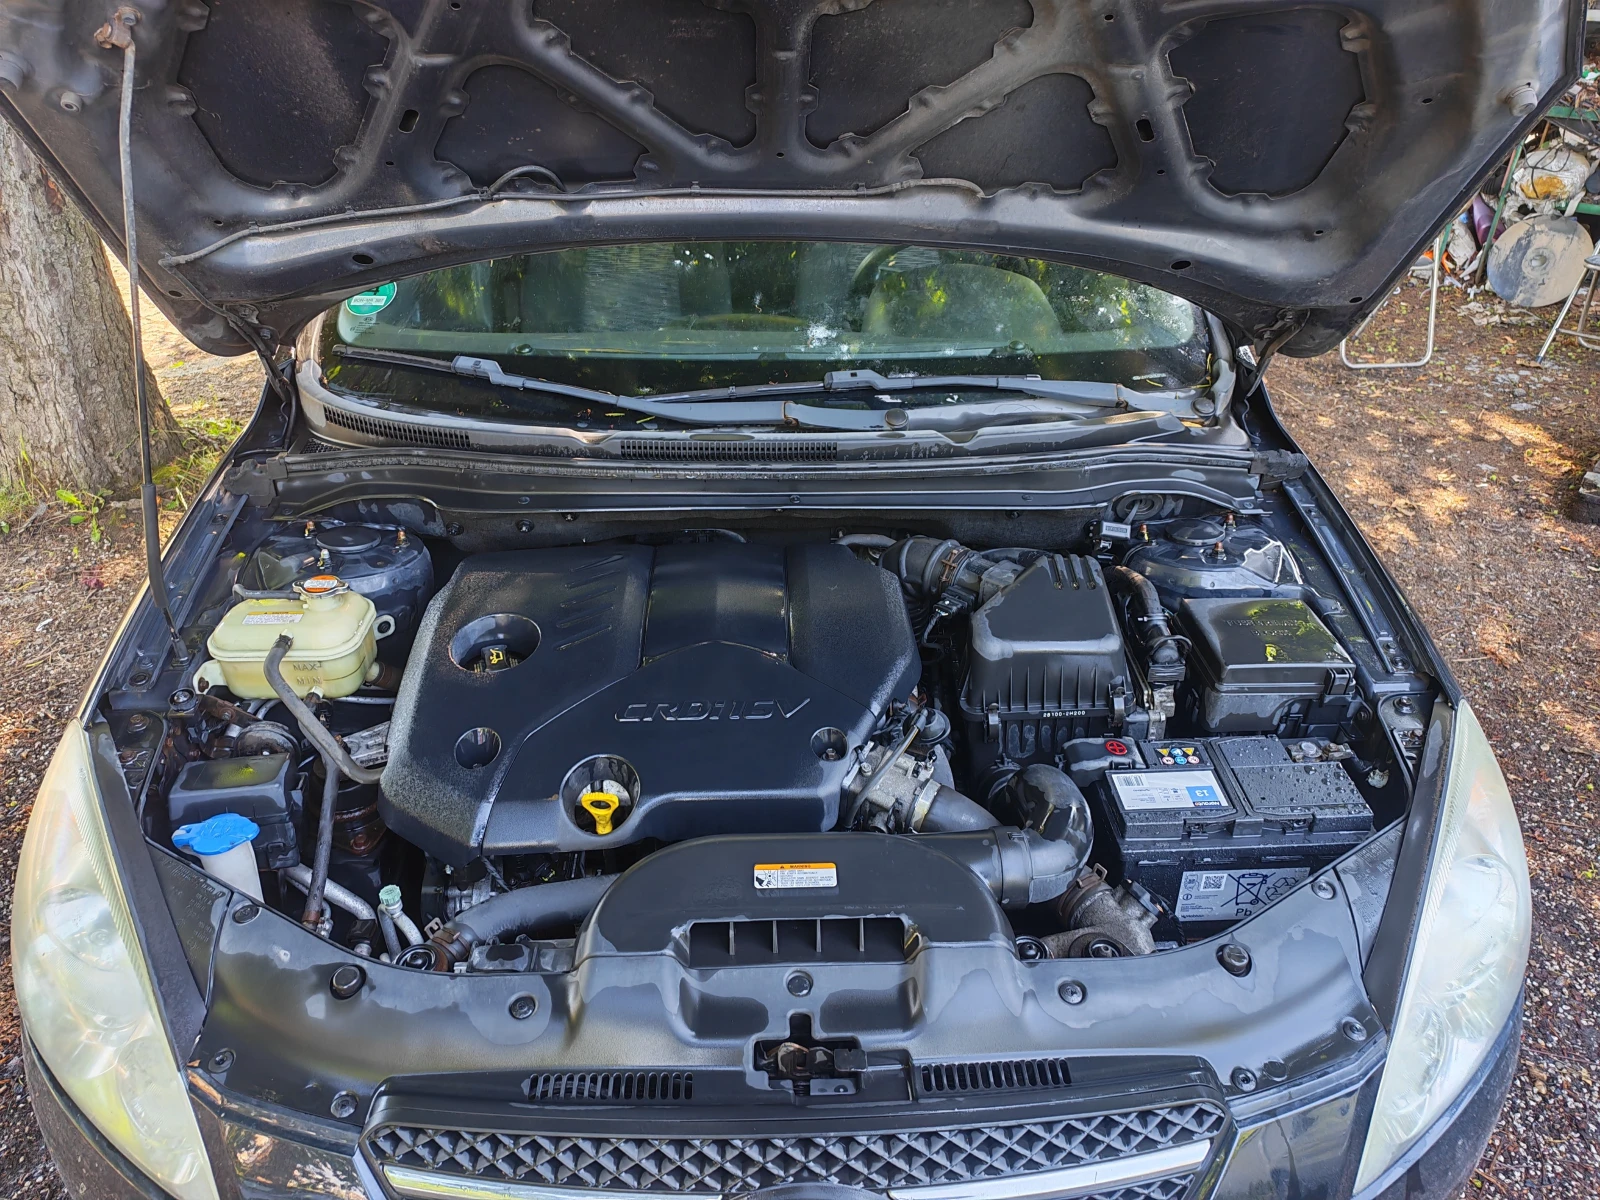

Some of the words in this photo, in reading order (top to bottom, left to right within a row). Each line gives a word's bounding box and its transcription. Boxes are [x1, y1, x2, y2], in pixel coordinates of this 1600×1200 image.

[293, 662, 318, 671] MAX
[296, 676, 322, 685] MIN
[1195, 789, 1209, 797] 13
[1235, 908, 1253, 917] Pb
